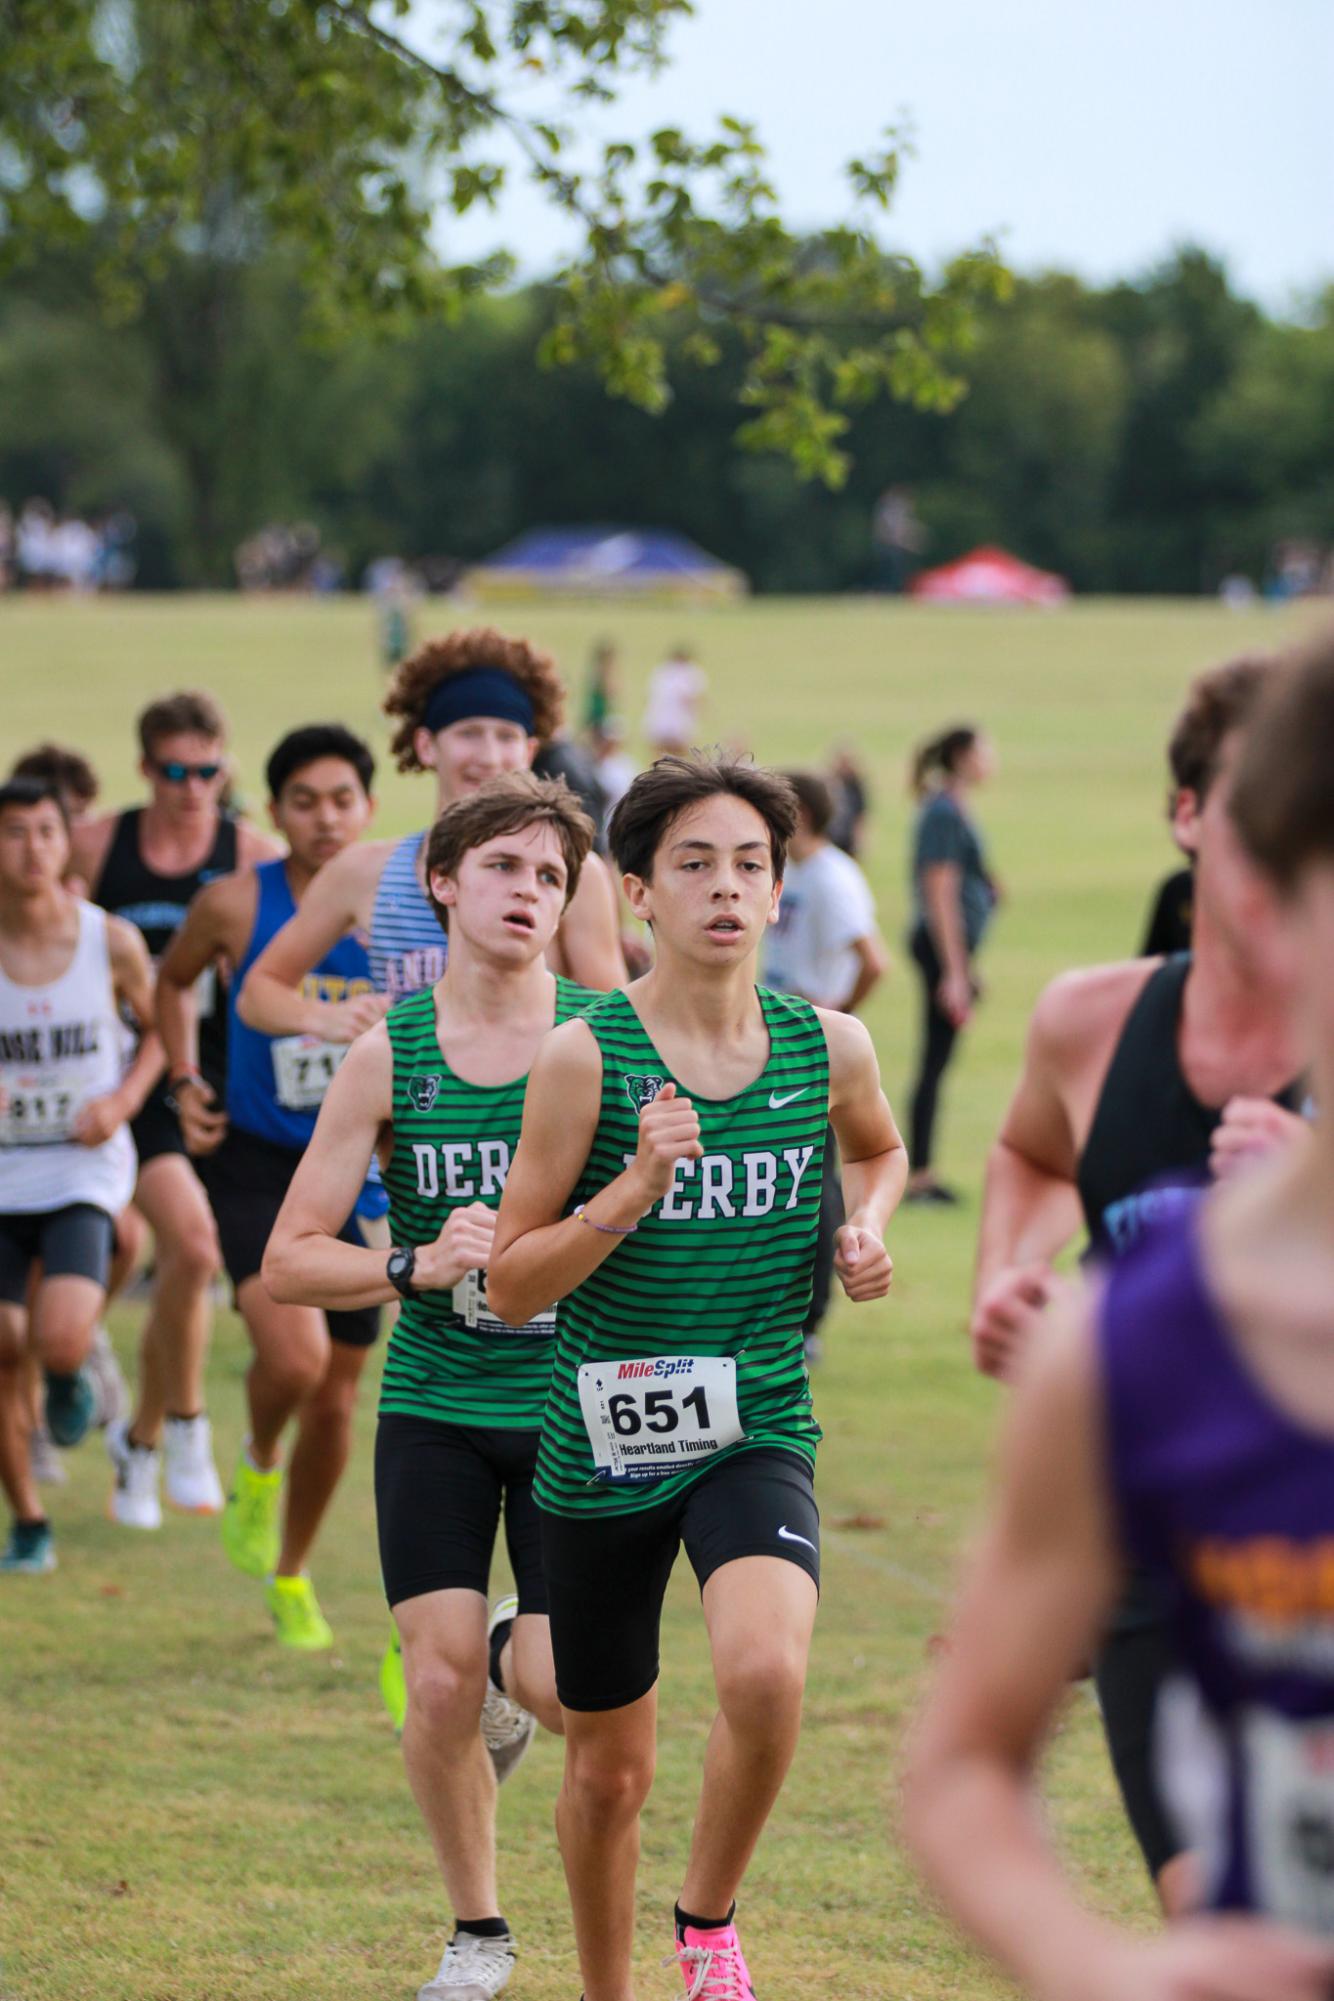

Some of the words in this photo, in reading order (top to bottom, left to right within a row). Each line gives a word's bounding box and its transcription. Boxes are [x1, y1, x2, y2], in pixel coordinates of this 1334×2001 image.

[411, 1139, 520, 1198] DER
[622, 1145, 815, 1221] ERBY
[617, 1358, 695, 1380] MileSplit
[608, 1386, 711, 1436] 651
[619, 1440, 676, 1456] Heartland
[680, 1439, 718, 1453] Timing
